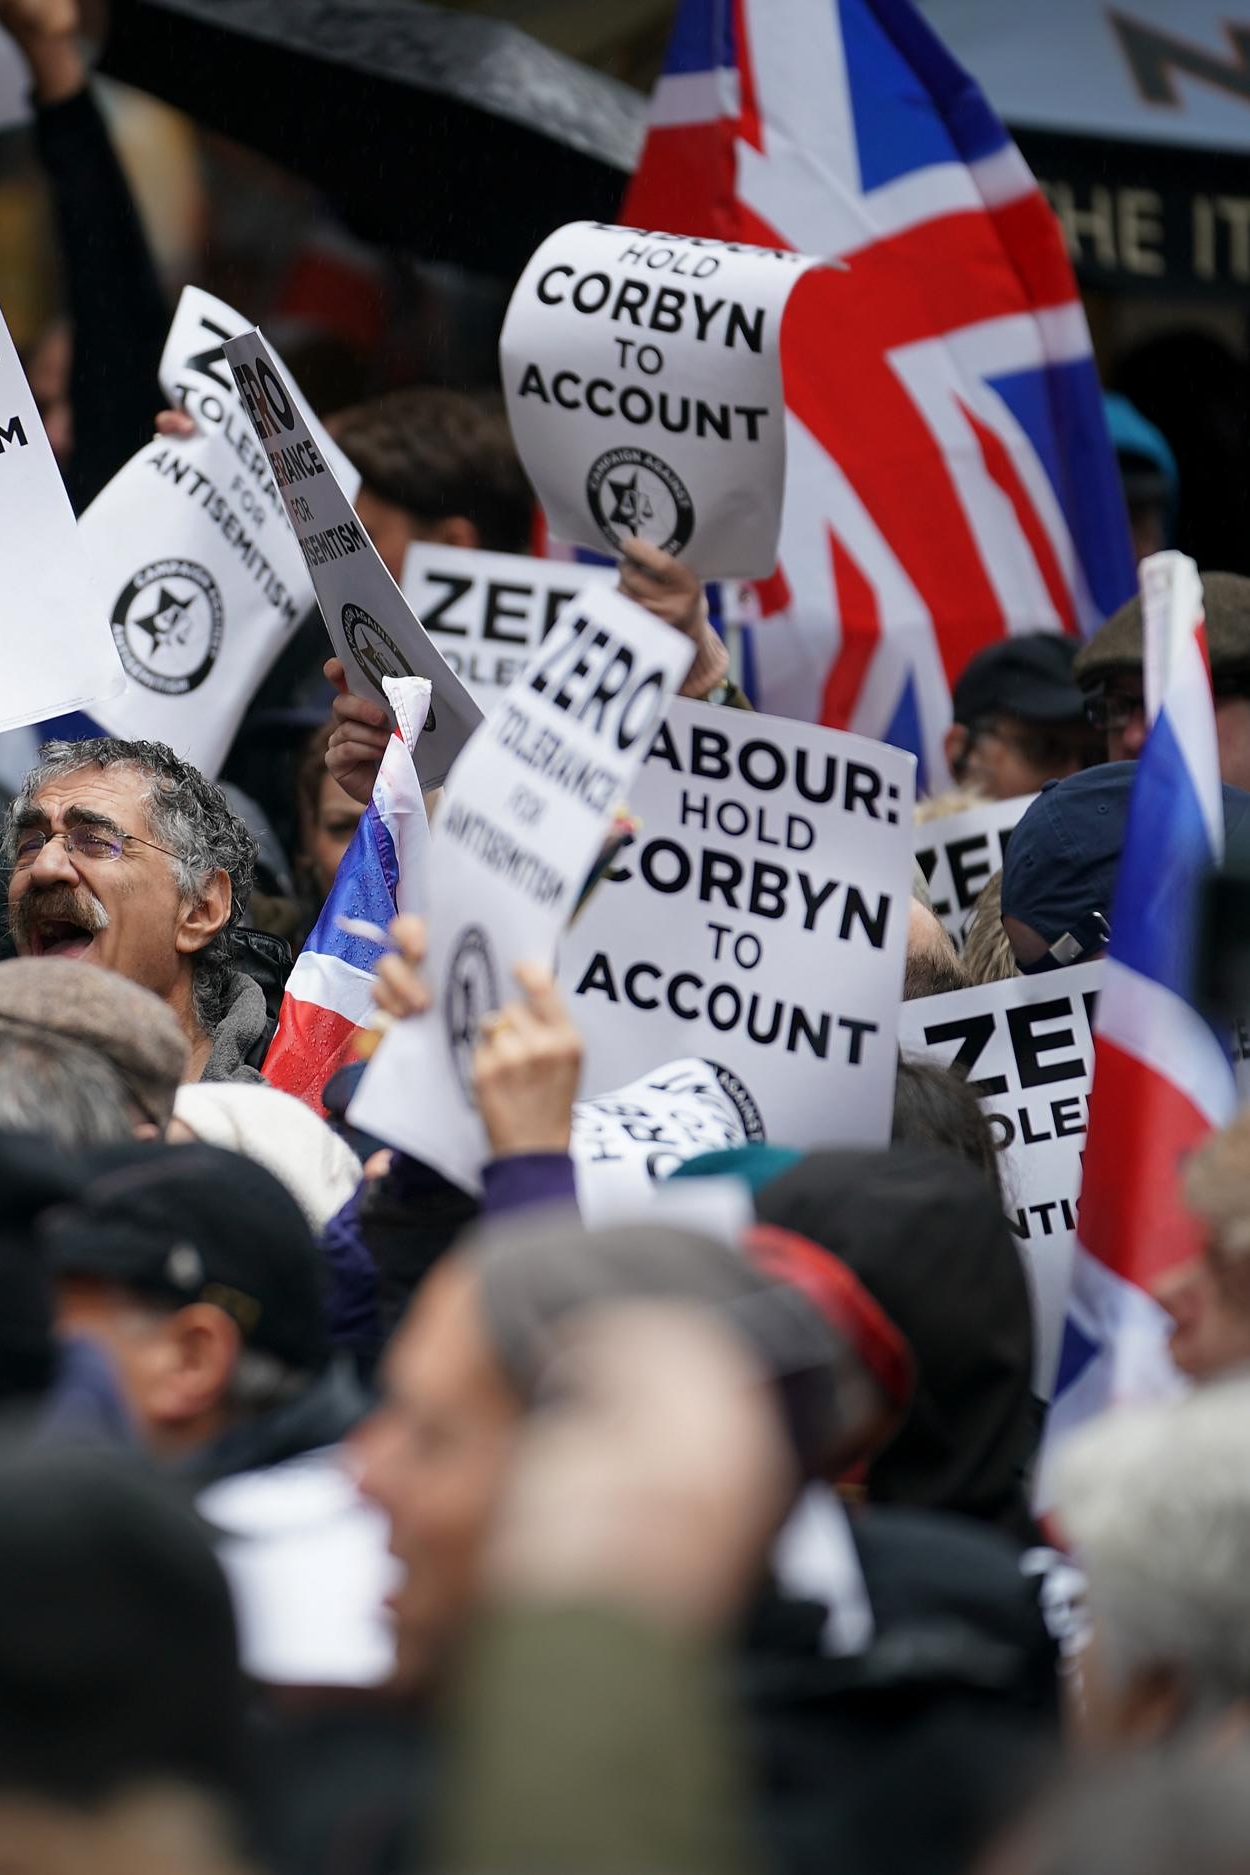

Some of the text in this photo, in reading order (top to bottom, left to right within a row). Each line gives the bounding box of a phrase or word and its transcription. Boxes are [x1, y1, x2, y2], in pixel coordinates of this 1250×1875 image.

[618, 243, 721, 278] HOLD
[537, 265, 766, 353] CORBYN
[614, 337, 664, 375] TO
[233, 357, 295, 440] ERO
[518, 362, 769, 441] ACCOUNT
[291, 496, 315, 522] FOR
[643, 719, 899, 825] ABOUR:
[680, 789, 815, 851] HOLD
[707, 921, 763, 969] TO
[575, 952, 879, 1066] ACCOUNT
[924, 989, 1101, 1099] ZE
